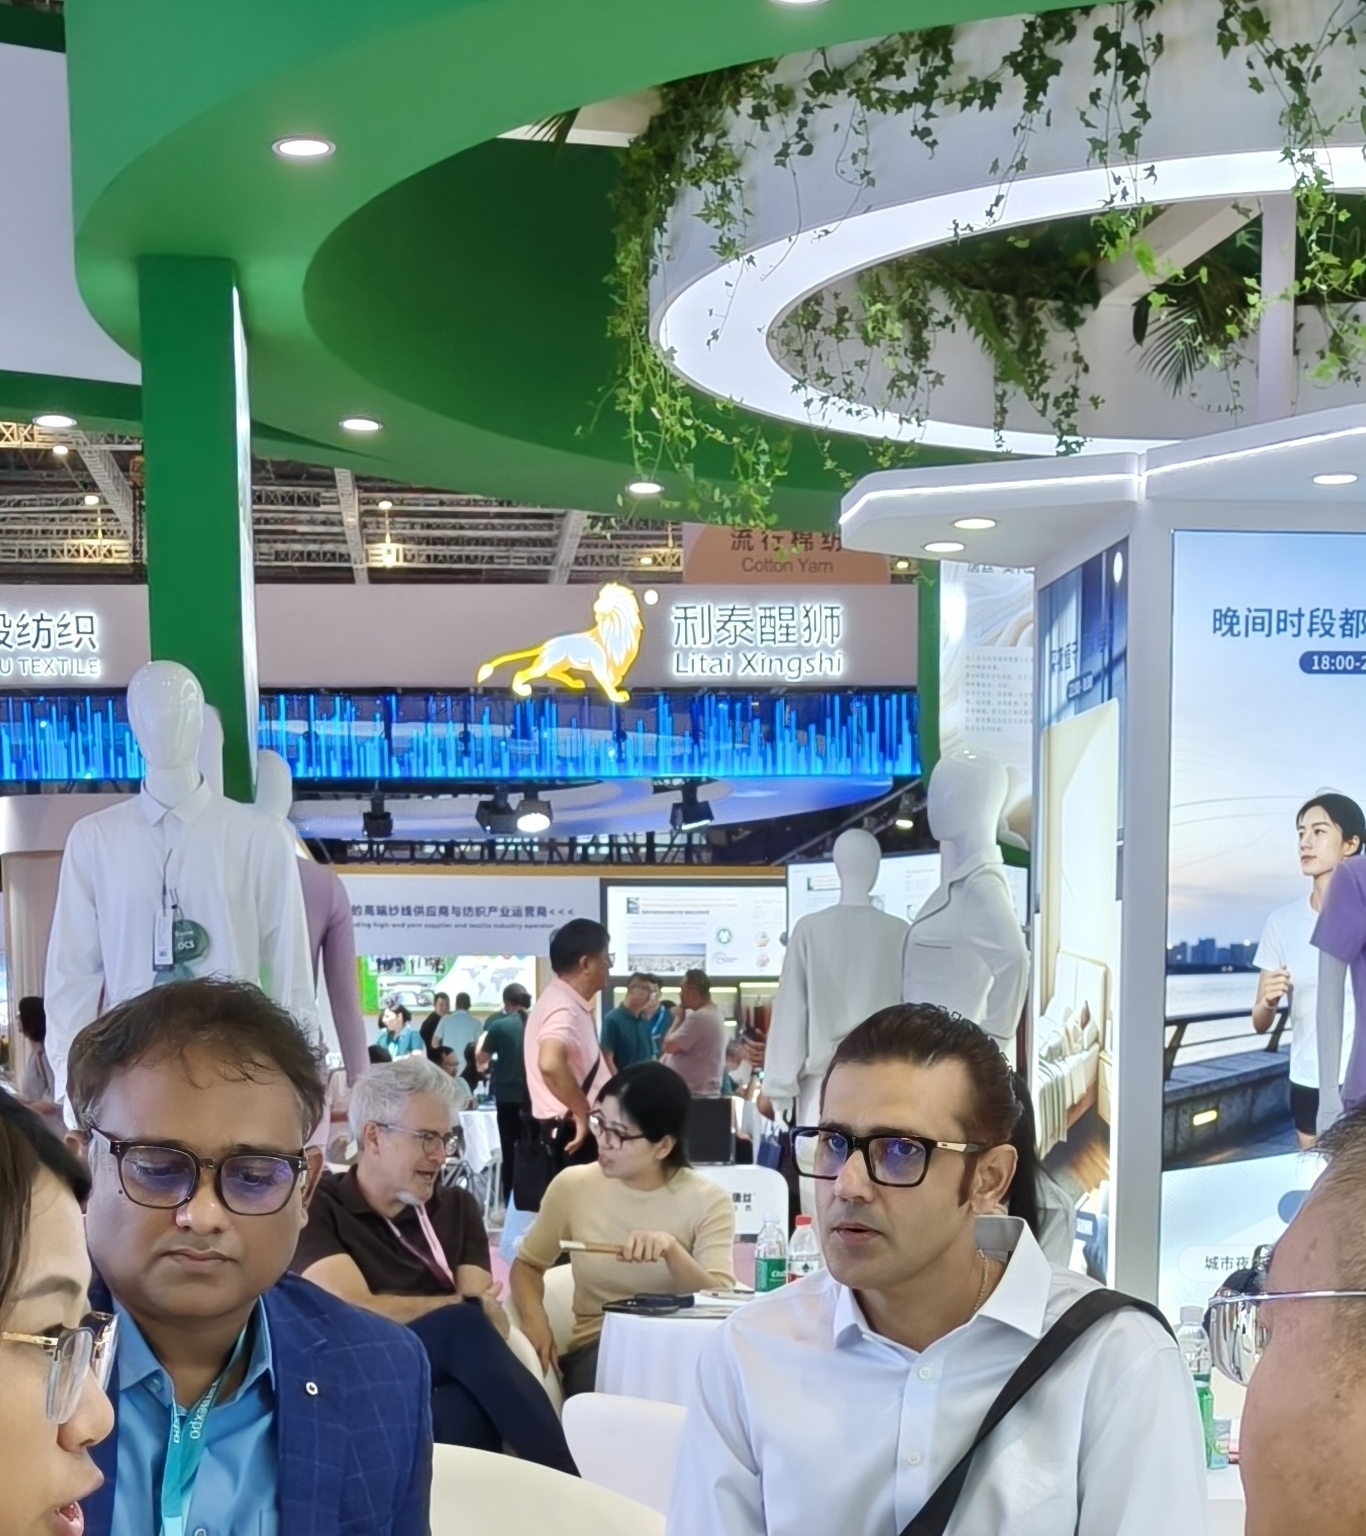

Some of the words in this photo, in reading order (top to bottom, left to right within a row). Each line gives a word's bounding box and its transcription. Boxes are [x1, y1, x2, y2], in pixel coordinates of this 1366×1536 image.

[742, 557, 793, 573] Cotton
[798, 558, 834, 573] Yarn
[674, 604, 841, 645] 利泰醒狮
[18, 658, 99, 675] TEXTILE
[676, 652, 732, 674] Litai
[740, 652, 843, 679] Xingshi
